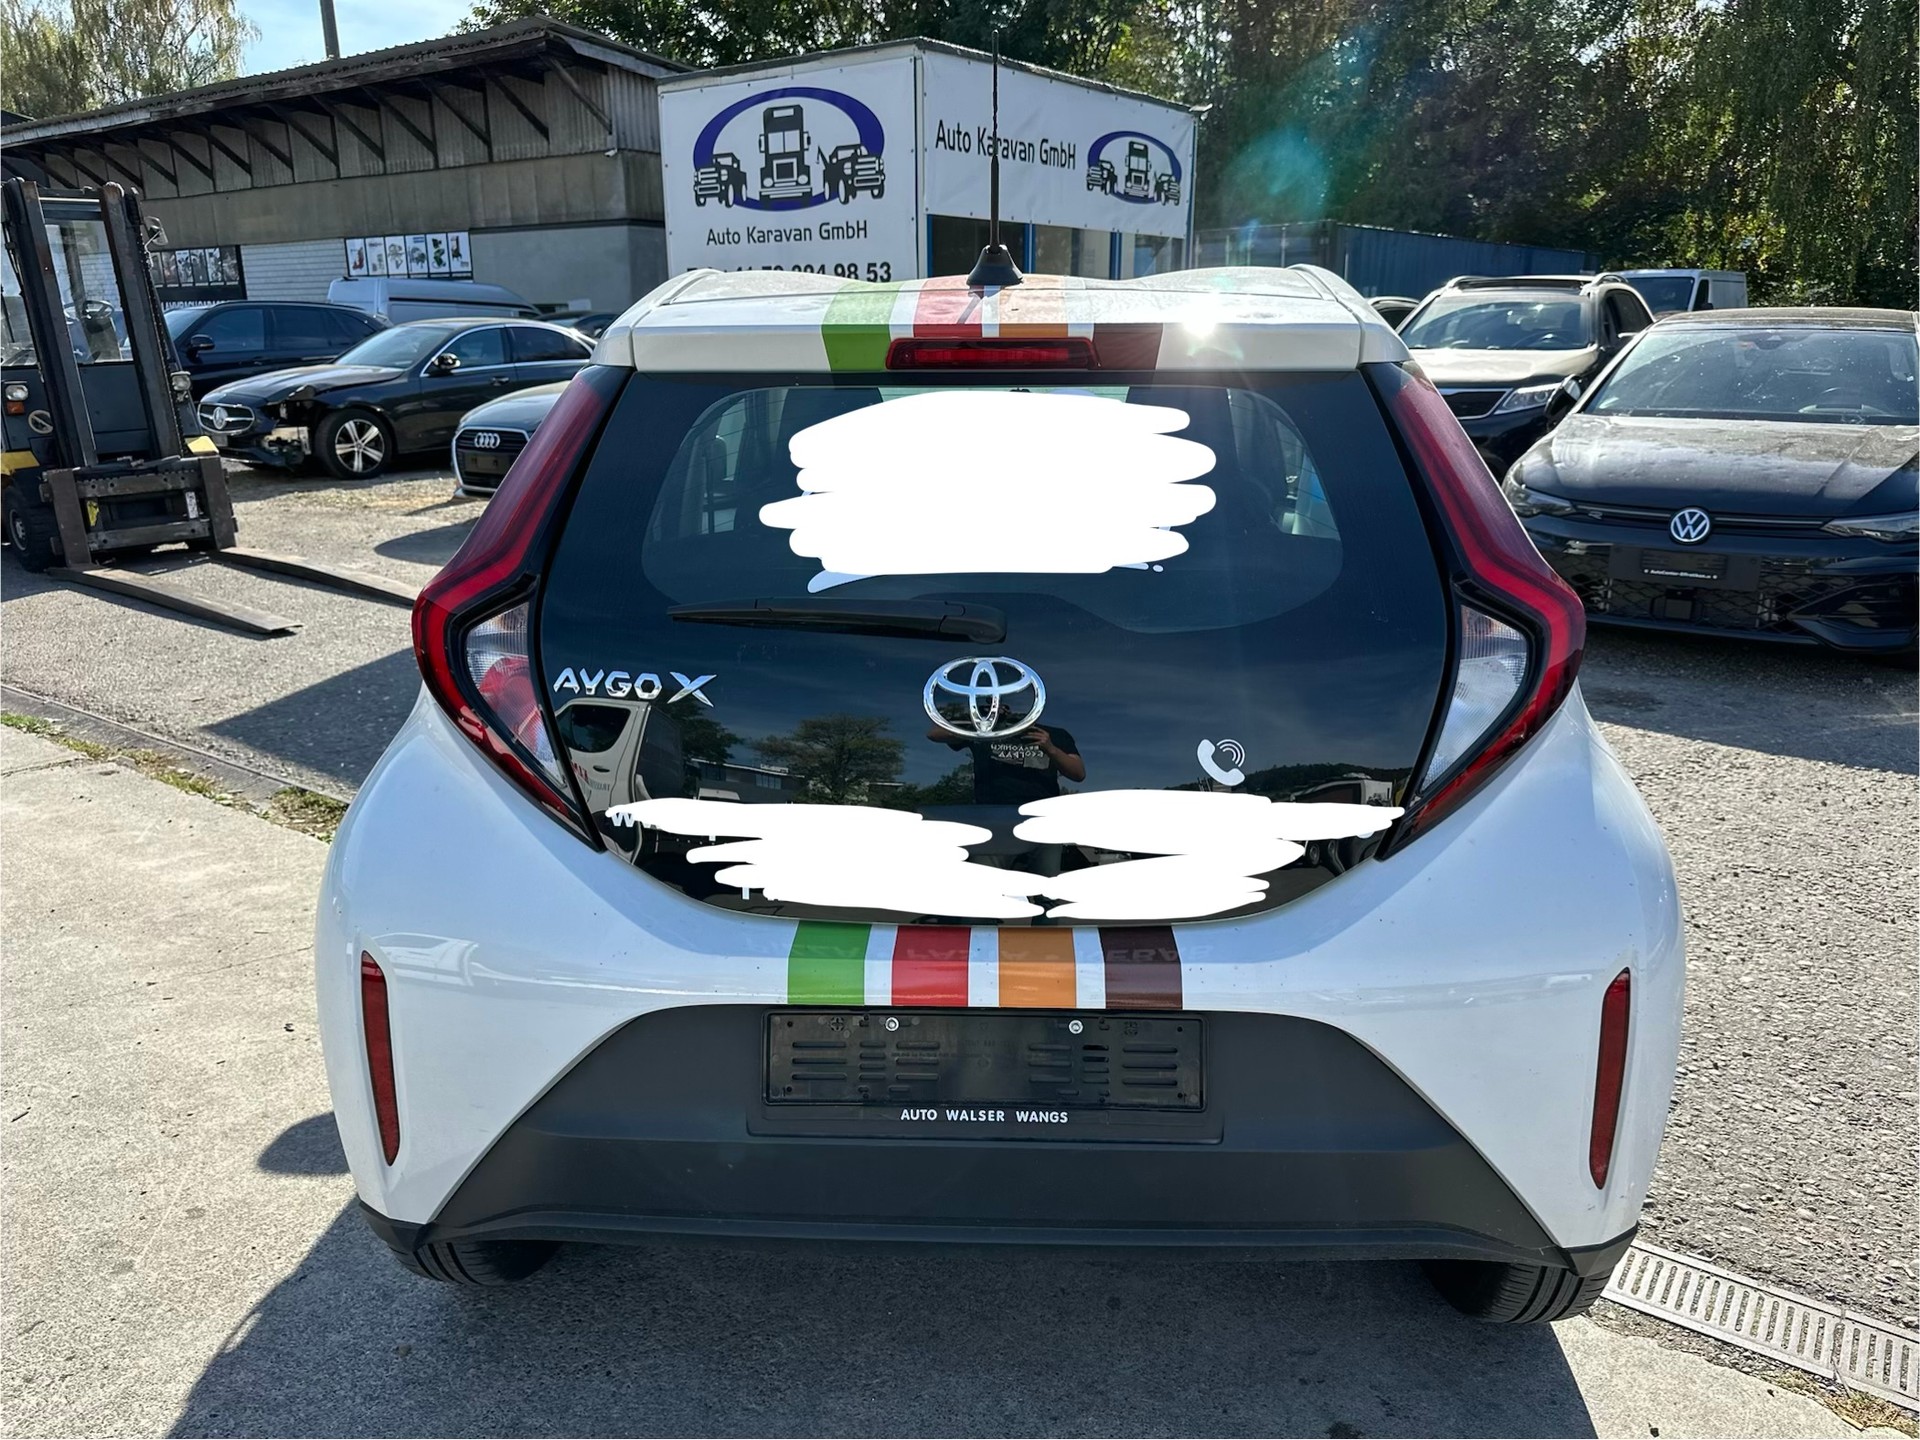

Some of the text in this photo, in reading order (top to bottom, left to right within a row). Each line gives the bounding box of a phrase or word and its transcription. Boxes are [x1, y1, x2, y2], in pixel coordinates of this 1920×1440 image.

[935, 119, 1076, 170] Auto Karavan GmbH
[706, 219, 868, 246] Auto Karavan GmbH
[866, 261, 892, 283] 53
[552, 666, 717, 708] AYGO X
[900, 1108, 1069, 1124] AUTO WALSER WANGS
